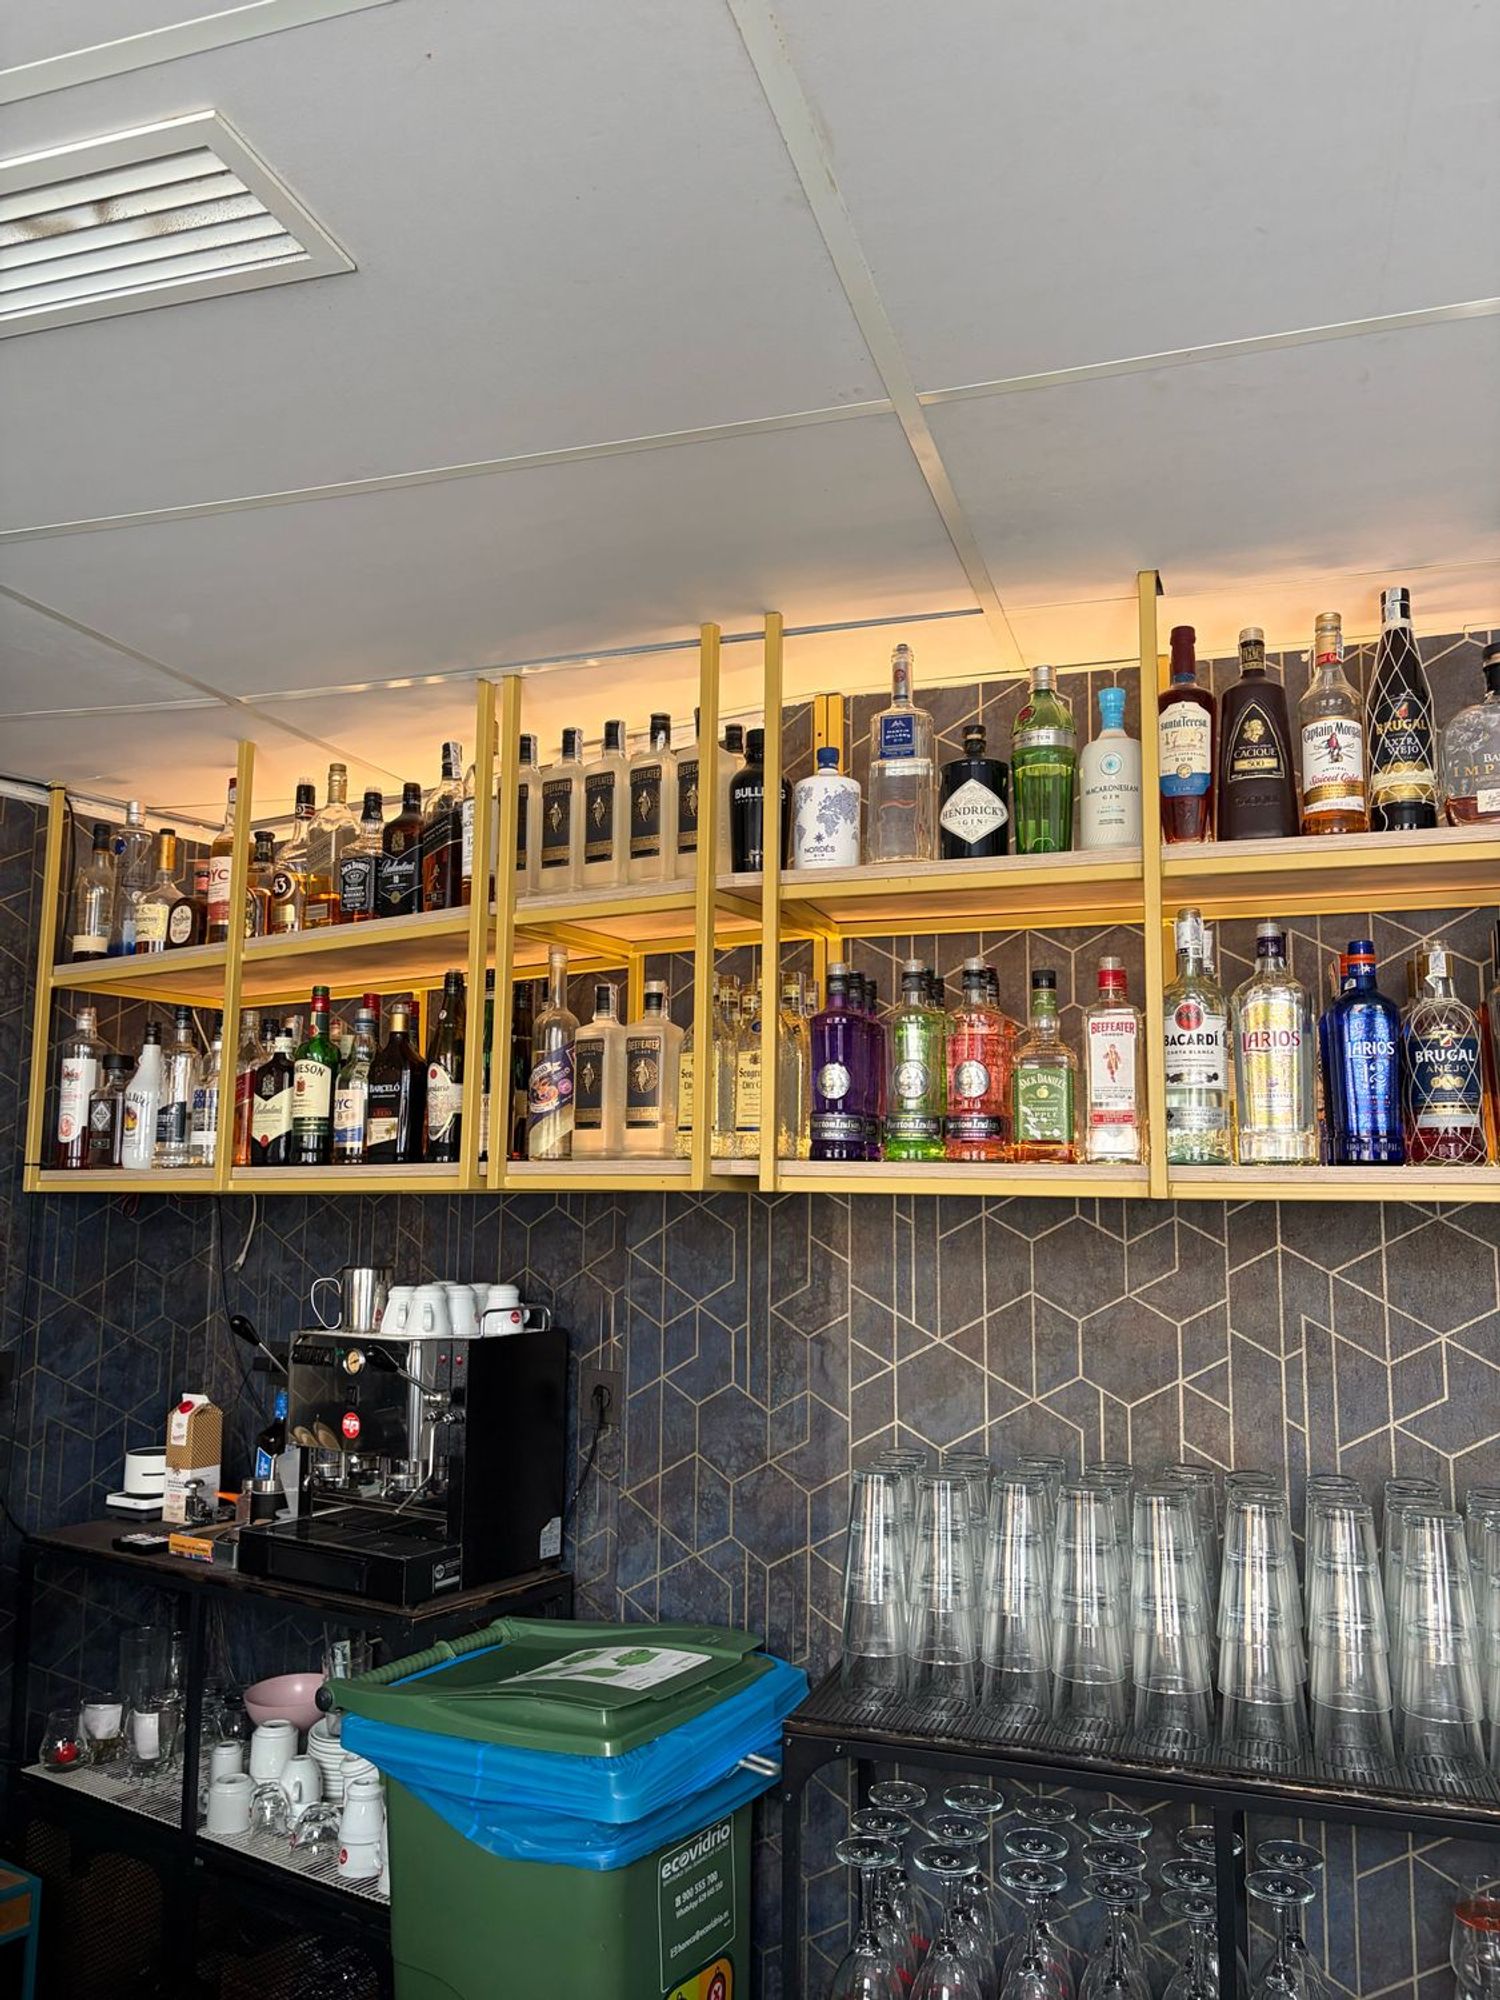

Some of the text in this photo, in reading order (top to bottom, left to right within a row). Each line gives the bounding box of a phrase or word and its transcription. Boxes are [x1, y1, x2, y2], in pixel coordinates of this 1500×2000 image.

[1302, 723, 1333, 743] Captain
[1376, 718, 1428, 736] BRUGAL
[1233, 747, 1278, 759] CACIQUE
[942, 805, 1005, 821] HENDRICK'S
[1090, 1021, 1135, 1035] BEEFEATER
[1163, 1030, 1219, 1047] BACARDÍ
[1242, 1030, 1301, 1053] LARIOS
[1346, 1040, 1396, 1059] LARIOS
[1414, 1048, 1475, 1063] BRUGAL
[369, 1082, 401, 1094] BARCELÓ
[661, 1824, 731, 1879] ecovidrio
